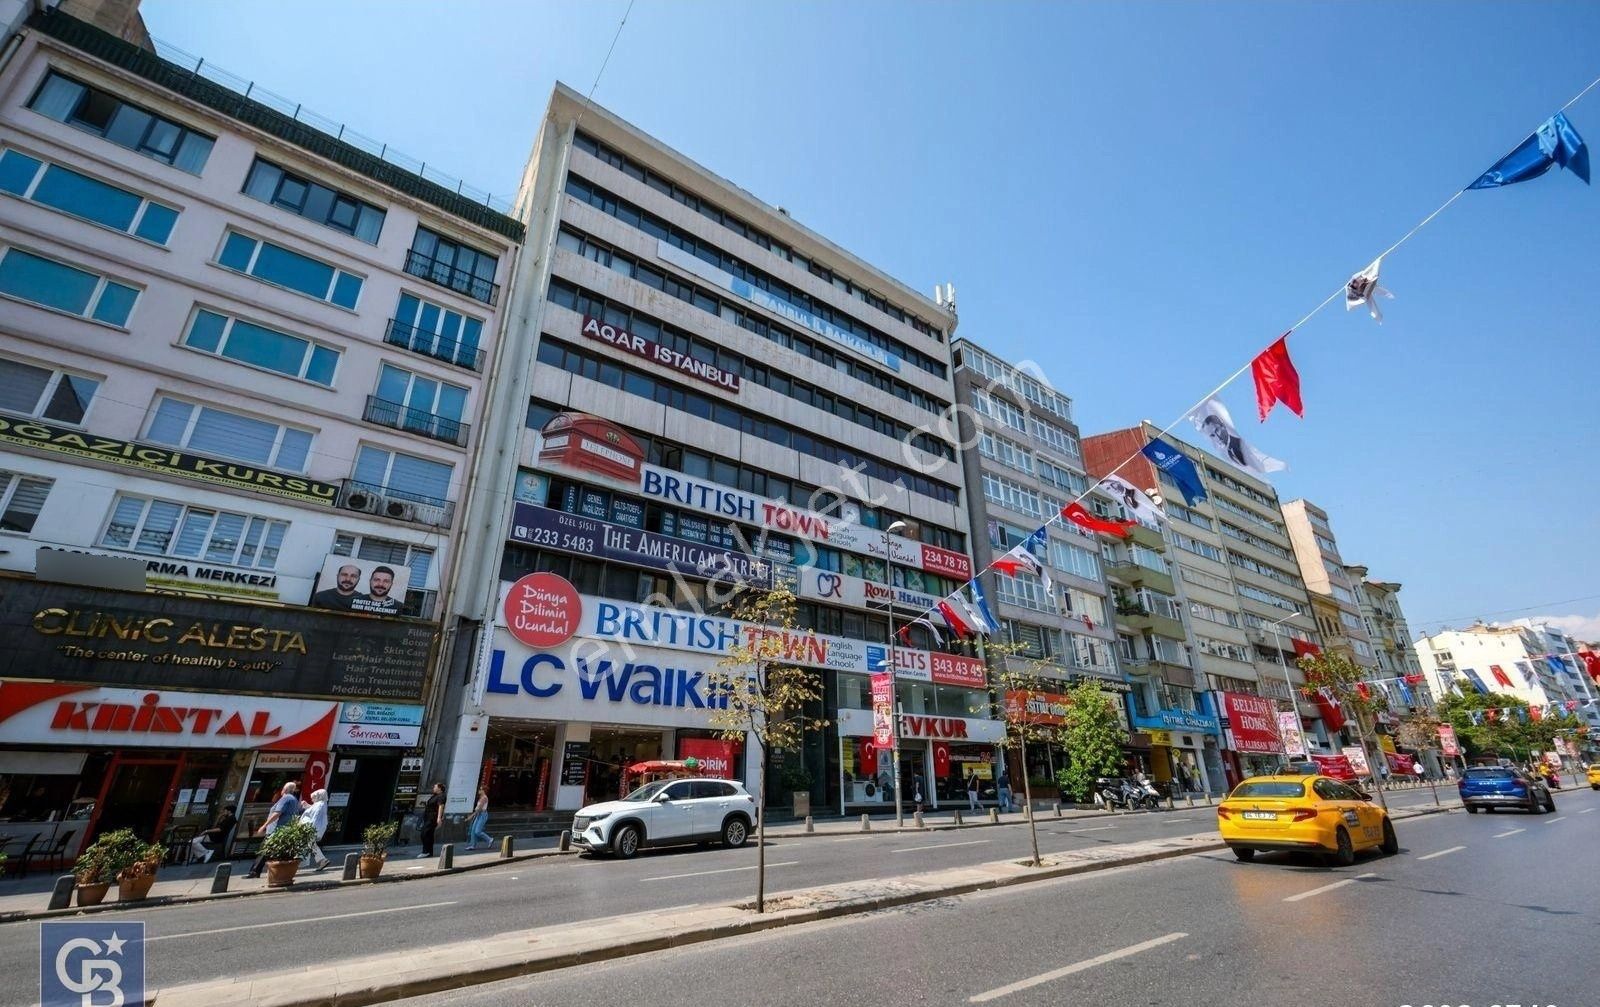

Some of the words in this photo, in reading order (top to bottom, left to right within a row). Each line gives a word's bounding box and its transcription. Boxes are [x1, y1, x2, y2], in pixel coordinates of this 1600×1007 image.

[584, 318, 647, 354] AQAR
[654, 344, 739, 389] ISTANBUL
[195, 459, 335, 497] KURSU
[644, 469, 755, 521] BRITISH
[761, 503, 829, 539] TOWN
[559, 515, 576, 527] ÖZEL
[533, 527, 559, 546] 233
[562, 534, 594, 553] 5483
[602, 524, 632, 550] THE
[637, 532, 717, 570] AMERICAN
[924, 549, 942, 564] 234
[943, 554, 955, 568] 78
[956, 558, 969, 572] 78
[195, 566, 278, 589] MERKEZİ
[523, 584, 568, 607] Dünya
[898, 590, 934, 608] HEALTH
[520, 600, 566, 619] Dilimin
[407, 628, 432, 638] Filler
[515, 615, 569, 636] Ucunda!
[596, 602, 740, 651] BRITISH
[743, 625, 827, 664] TOWN
[176, 621, 307, 655] ALESTA
[402, 638, 429, 648] Botox
[827, 638, 853, 651] English
[97, 650, 149, 662] center
[152, 653, 169, 664] of
[171, 654, 226, 670] healthy
[361, 654, 383, 664] Hair
[385, 656, 425, 668] Removal
[383, 646, 405, 656] Skin
[407, 648, 428, 658] Care
[827, 648, 863, 661] Language
[888, 648, 926, 670] IELTS
[345, 663, 368, 673] Hair
[371, 665, 424, 677] Treatments
[827, 658, 855, 669] Schools
[933, 657, 953, 672] 343
[955, 661, 968, 676] 43
[343, 674, 365, 684] Skin
[368, 675, 421, 688] Treatments
[487, 649, 566, 698] LC
[331, 684, 372, 695] Medical
[374, 687, 419, 698] Aesthetic
[902, 714, 969, 738] EVKUR
[1240, 714, 1268, 730] HOME
[350, 730, 389, 740] SMYRNA
